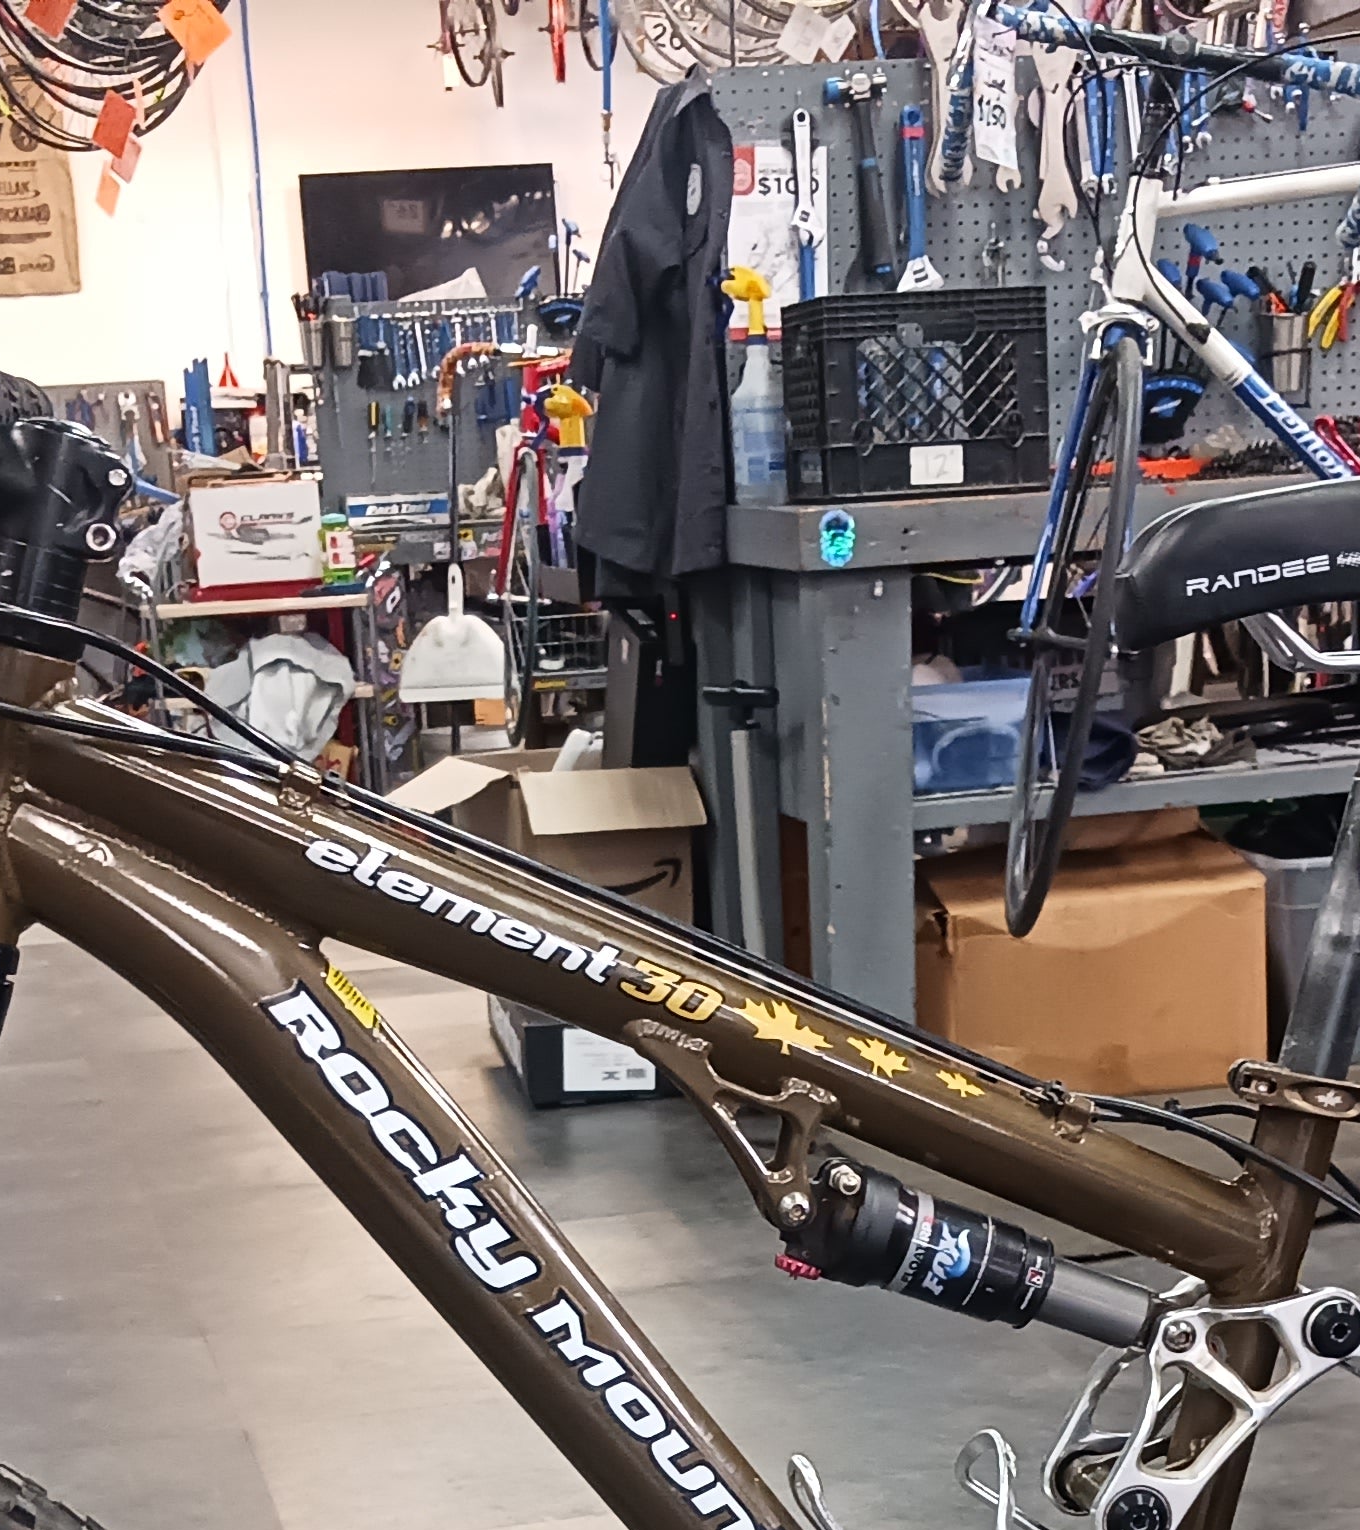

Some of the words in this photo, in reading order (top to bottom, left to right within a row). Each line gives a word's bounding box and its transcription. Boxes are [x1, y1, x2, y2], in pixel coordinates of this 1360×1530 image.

[1185, 554, 1331, 597] RANDEE
[304, 838, 622, 984] element
[620, 957, 724, 1023] 30
[921, 1219, 971, 1296] FOX
